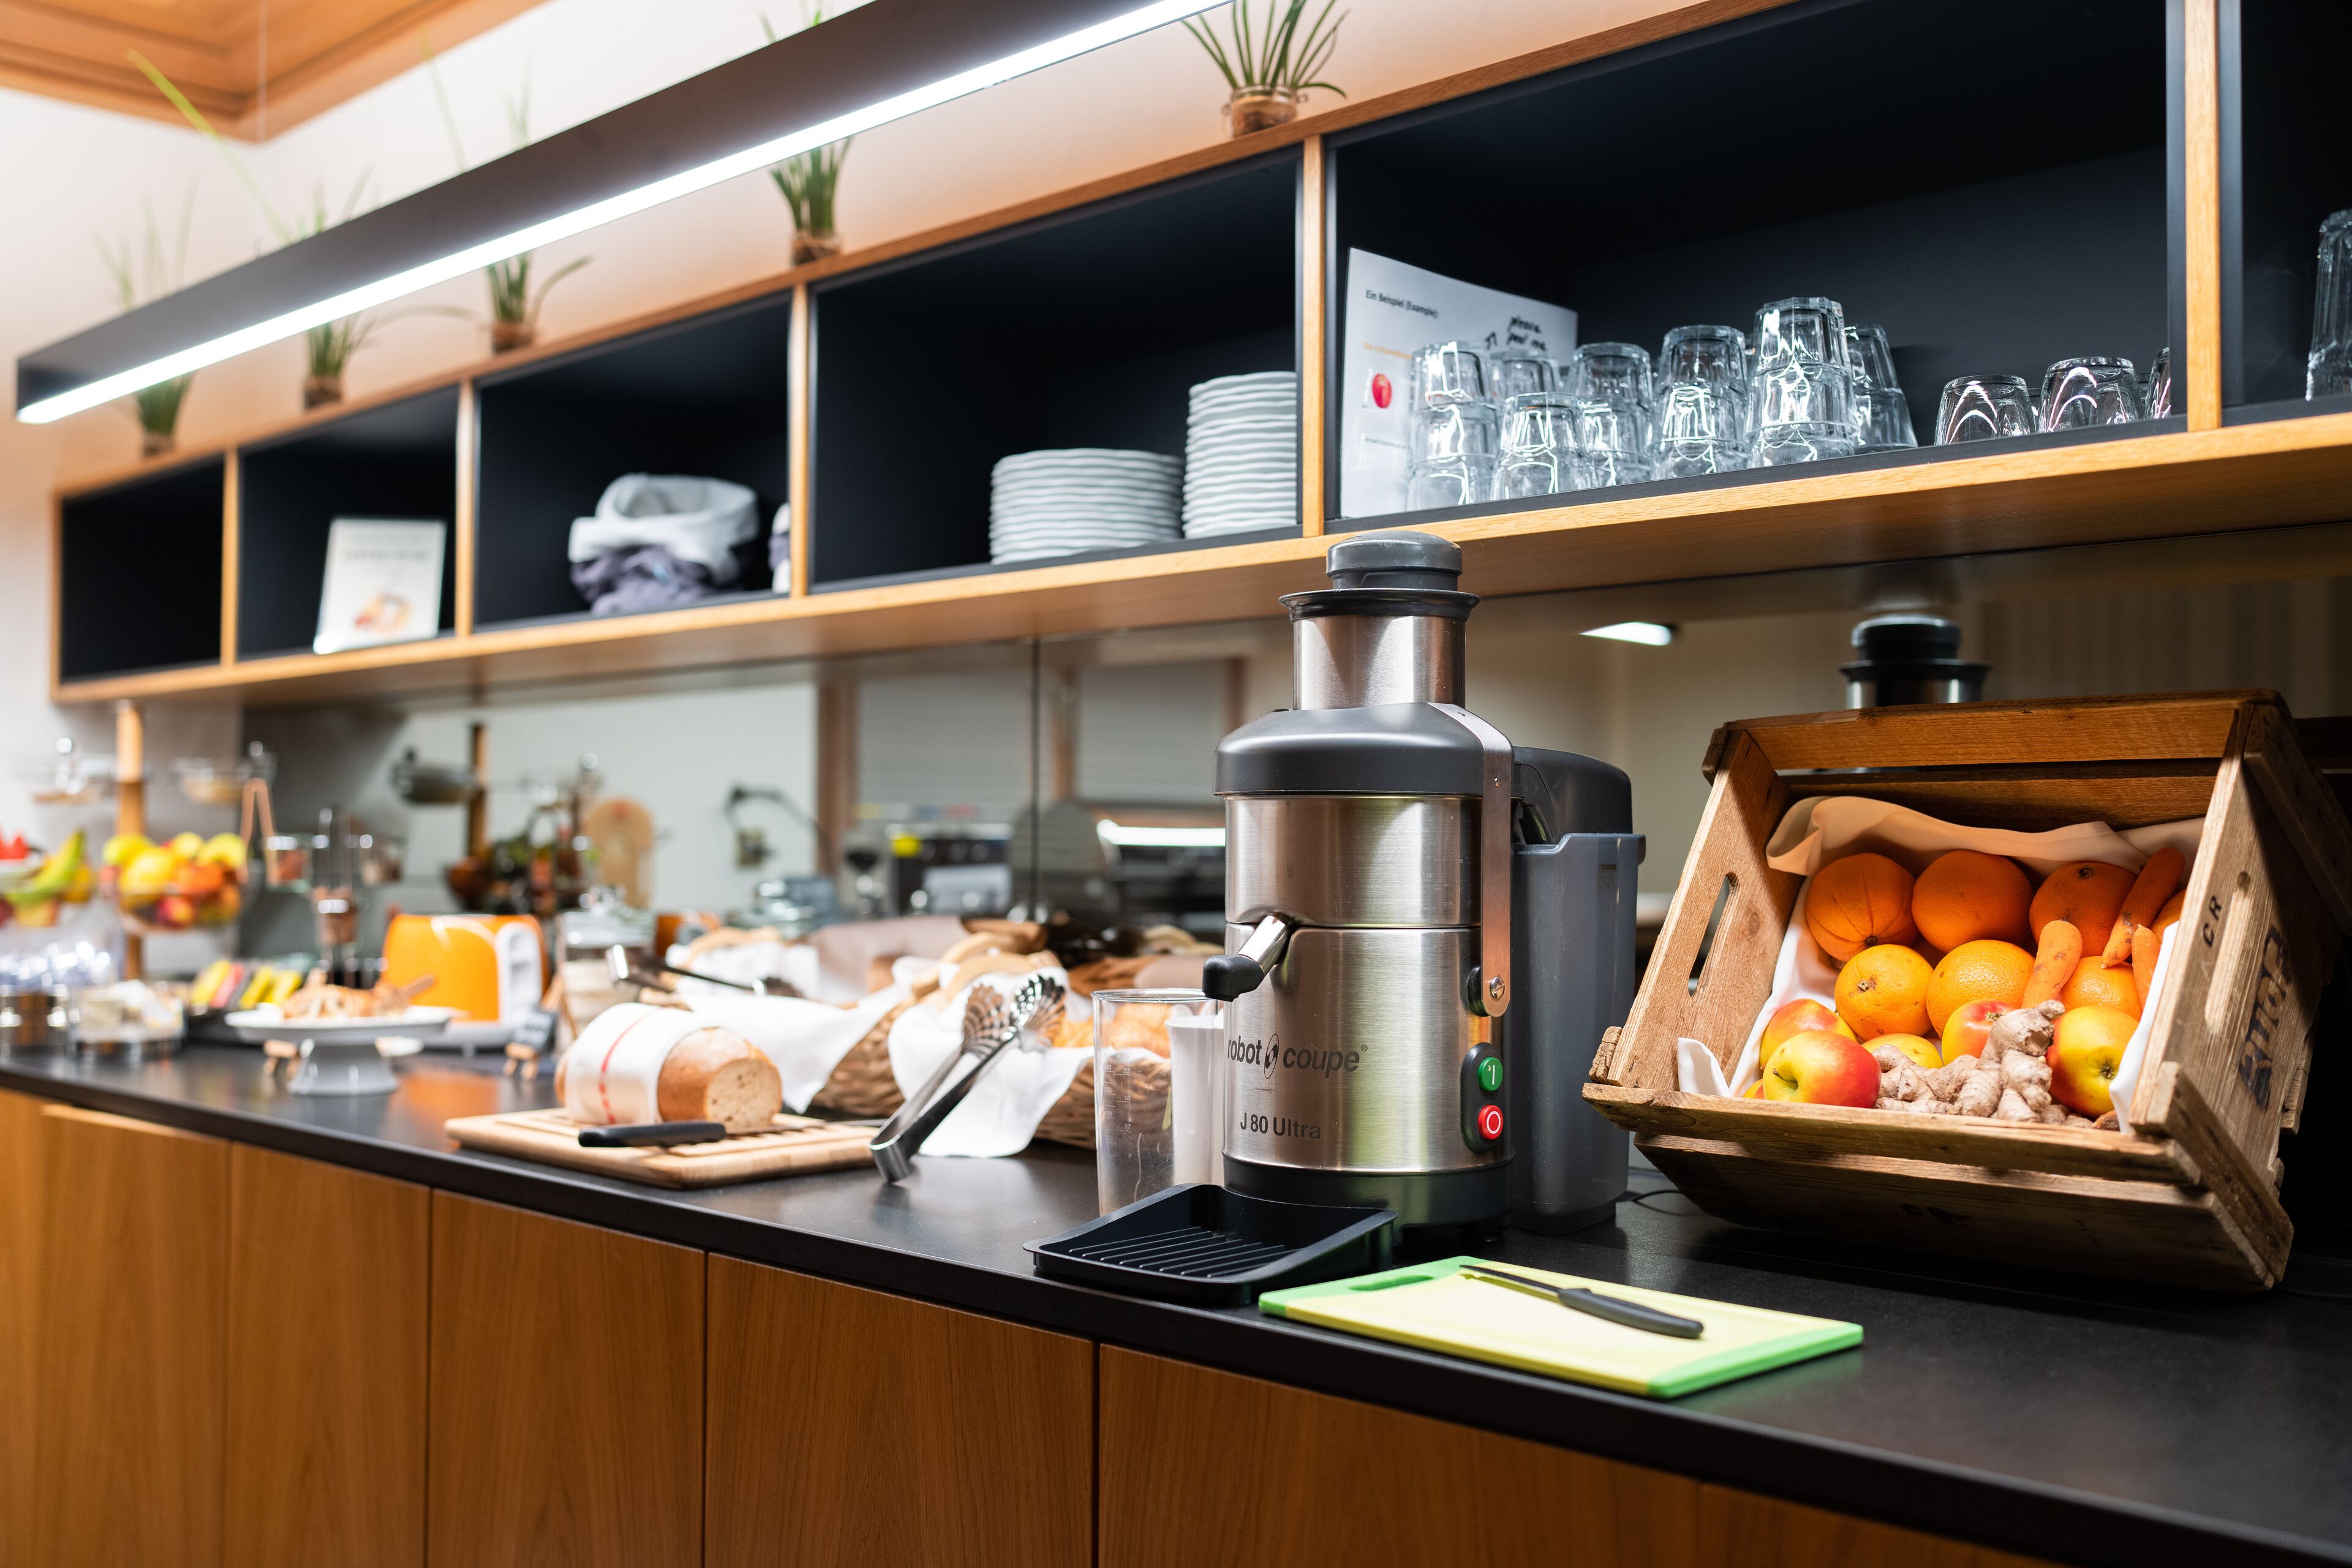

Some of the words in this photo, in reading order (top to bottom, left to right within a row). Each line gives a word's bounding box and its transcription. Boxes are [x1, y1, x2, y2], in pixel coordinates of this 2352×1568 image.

[1366, 289, 1377, 300] Ein
[1378, 293, 1404, 307] Beispiel
[1227, 1035, 1262, 1065] robot
[1240, 1112, 1247, 1131] J
[1250, 1114, 1268, 1134] 80
[1273, 1117, 1322, 1140] Ultra
